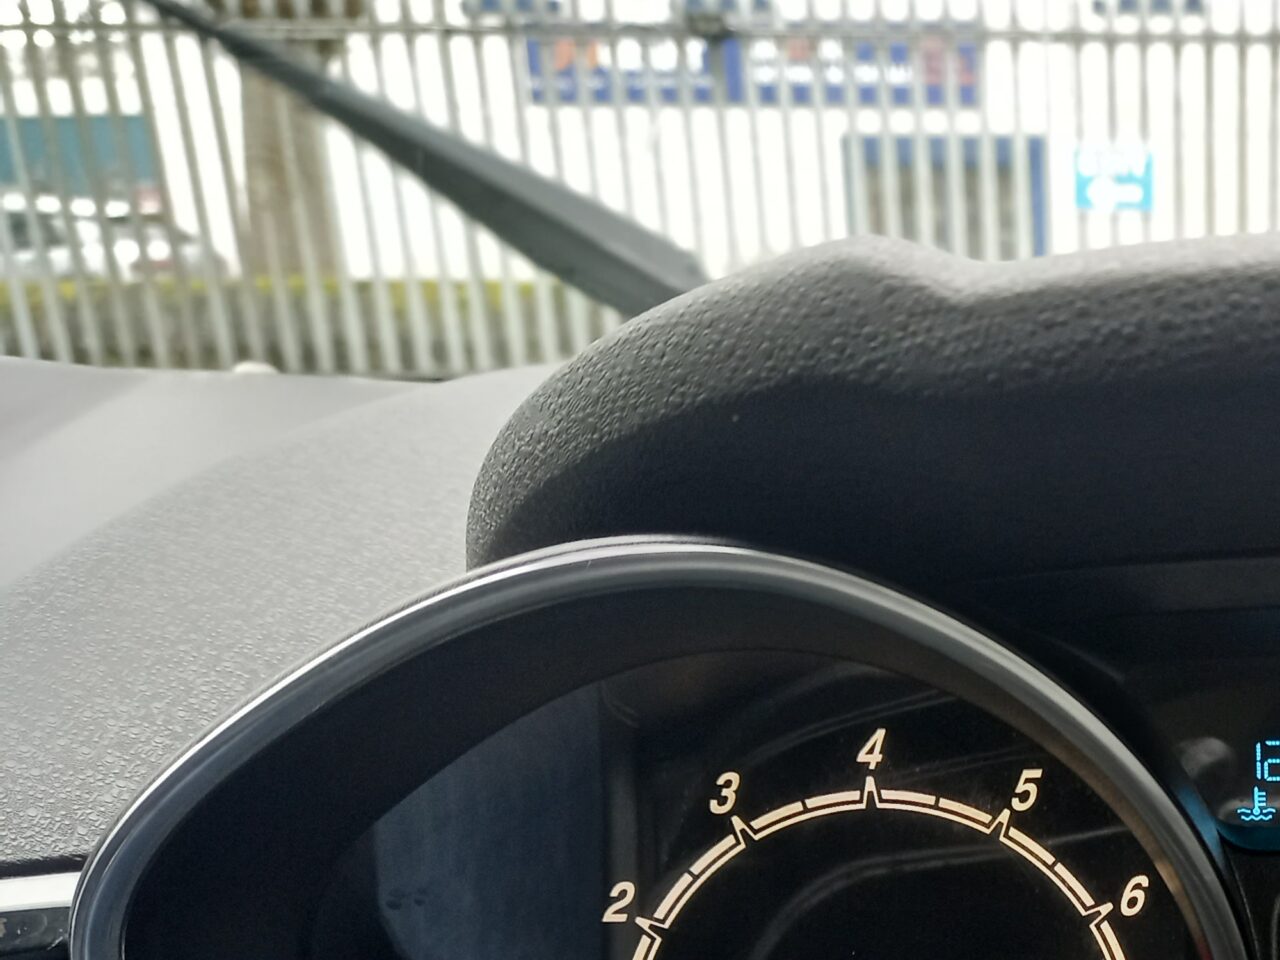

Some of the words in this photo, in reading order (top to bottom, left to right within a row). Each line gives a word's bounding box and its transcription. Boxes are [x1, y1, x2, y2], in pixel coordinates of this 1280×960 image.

[857, 728, 886, 769] 4
[709, 772, 741, 815] 3
[1011, 769, 1043, 811] 5
[602, 881, 635, 922] 2
[1120, 875, 1149, 916] 6
